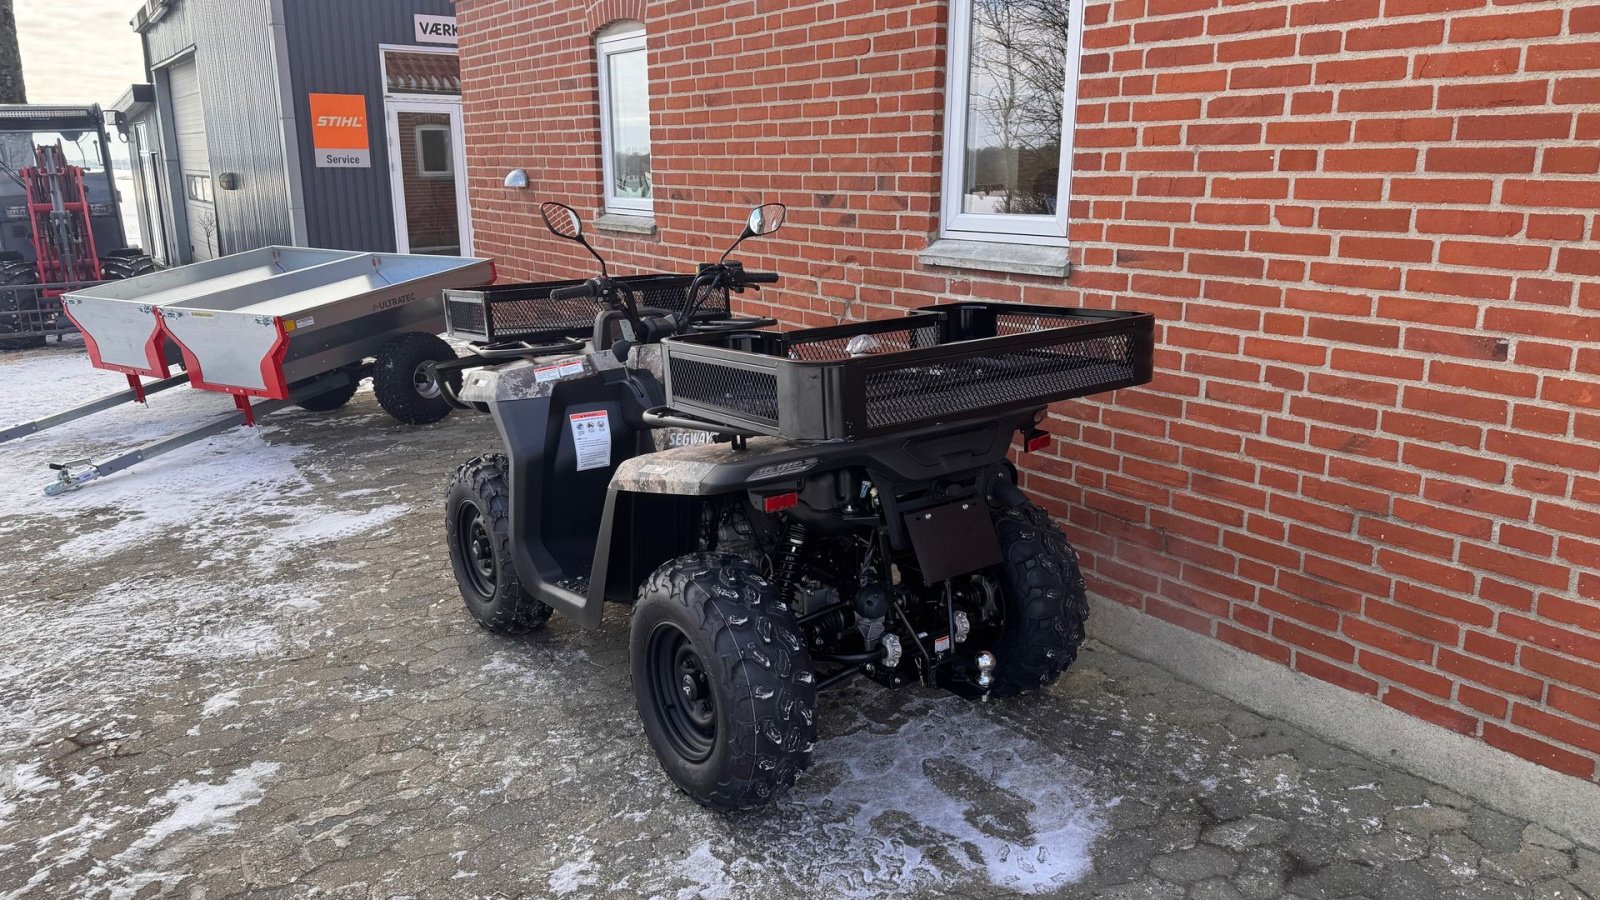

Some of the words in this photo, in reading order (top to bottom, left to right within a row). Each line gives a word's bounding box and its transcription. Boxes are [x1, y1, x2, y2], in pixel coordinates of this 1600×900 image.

[317, 115, 362, 128] STIHL
[326, 154, 360, 164] Service
[378, 292, 416, 309] ULTRATEC
[669, 431, 714, 446] SEGWAY
